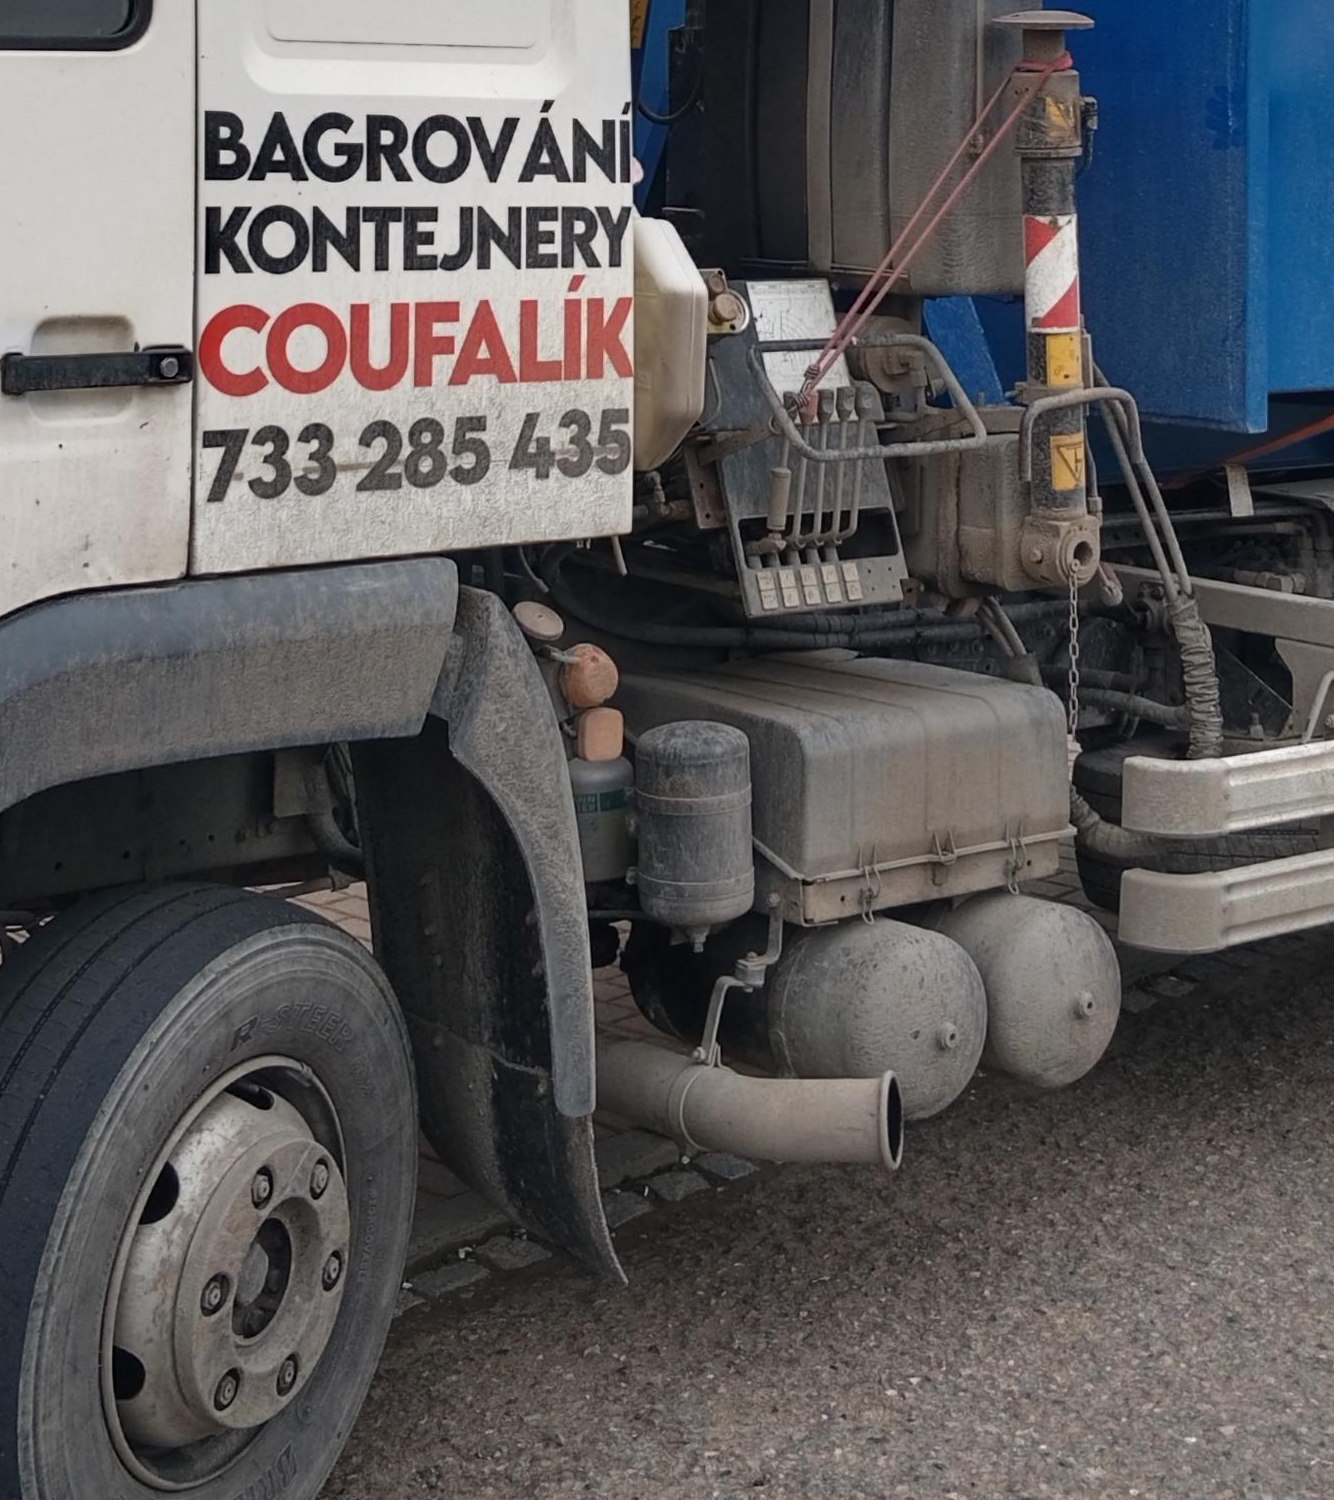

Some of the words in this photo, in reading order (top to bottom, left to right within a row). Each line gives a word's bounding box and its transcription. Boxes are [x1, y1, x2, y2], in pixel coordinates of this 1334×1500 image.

[204, 99, 633, 184] BAGROVÁNÍ
[204, 204, 633, 275] KONTEJNERY
[199, 274, 634, 397] COUFALÍK
[202, 421, 338, 504] 733
[356, 415, 492, 493] 285
[508, 408, 632, 481] 435
